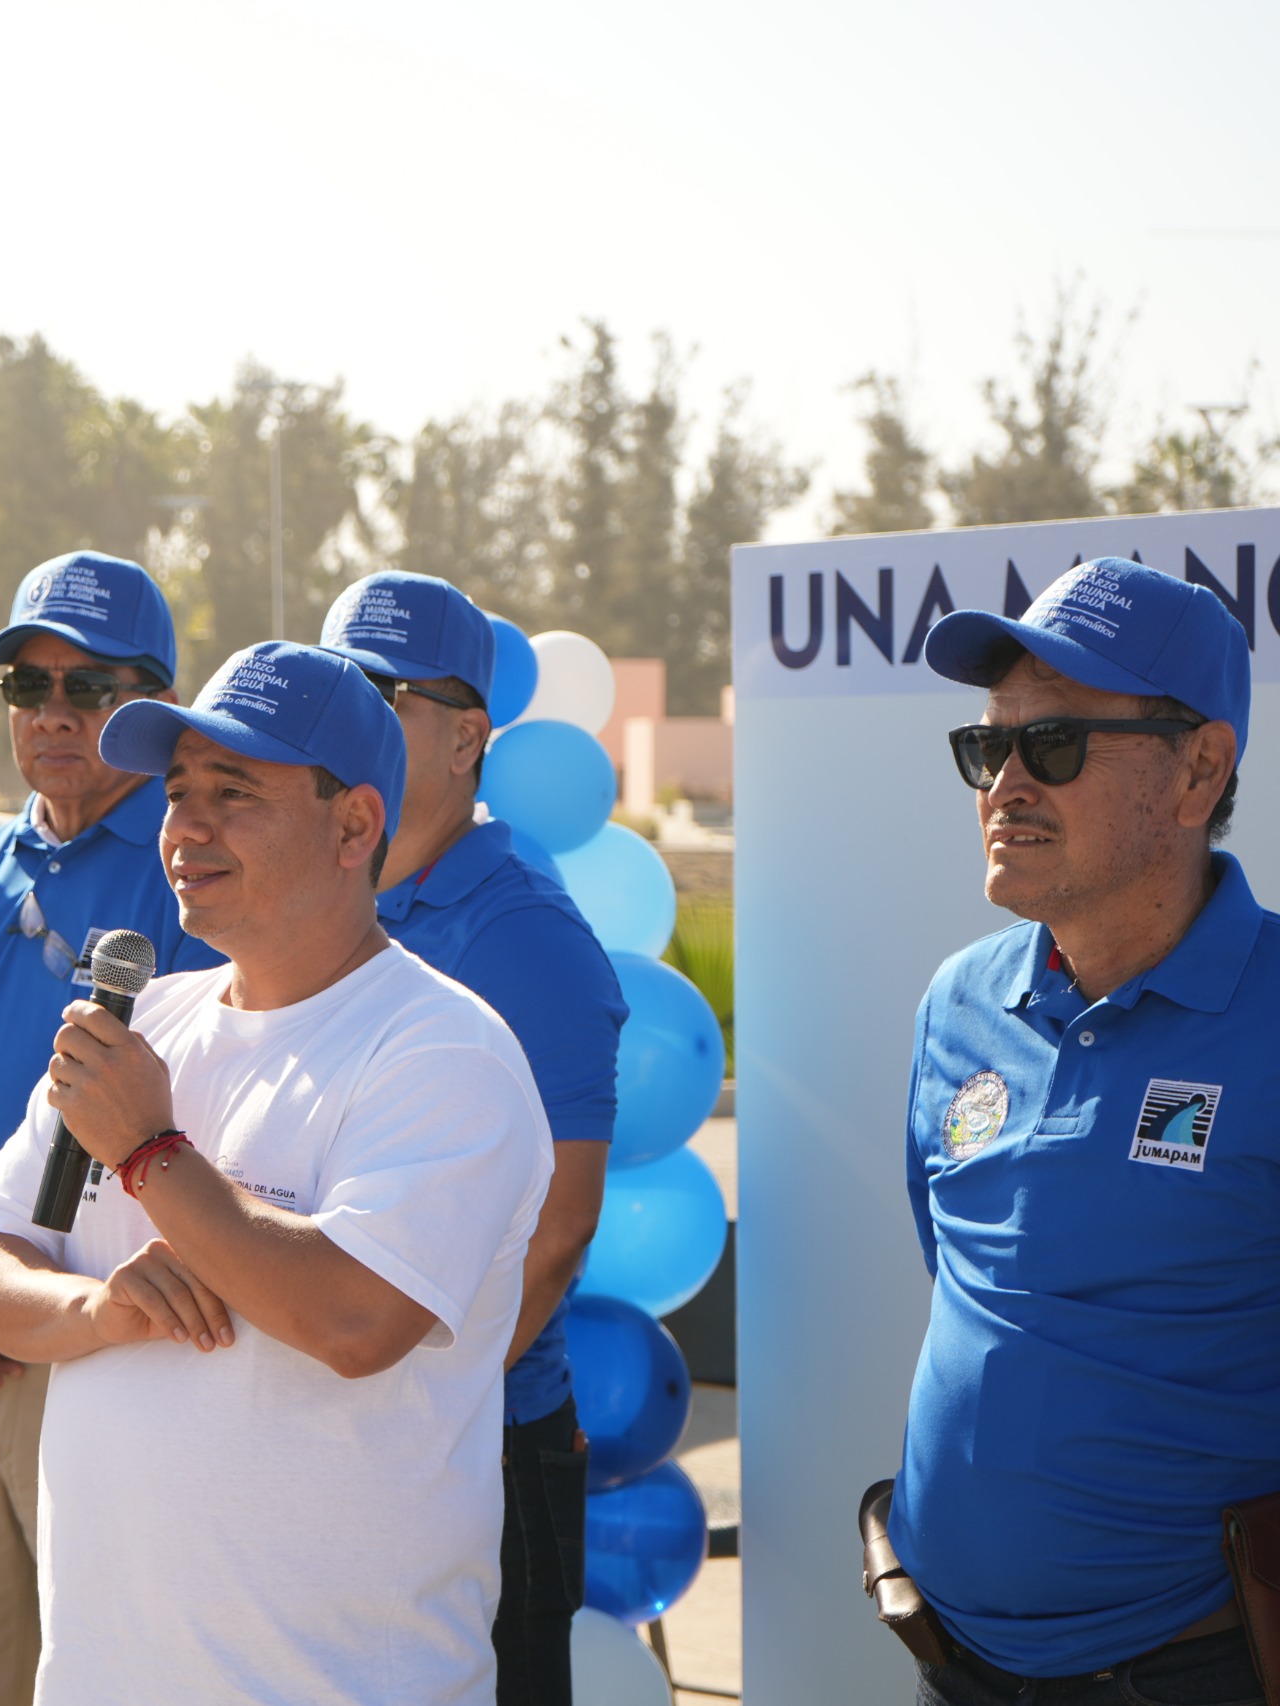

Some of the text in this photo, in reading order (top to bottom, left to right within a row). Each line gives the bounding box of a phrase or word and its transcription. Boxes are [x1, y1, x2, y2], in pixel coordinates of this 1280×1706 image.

[1076, 571, 1120, 592] MARZO
[1066, 591, 1106, 611] AGUA
[1073, 583, 1133, 611] MUNDIAL
[361, 613, 393, 624] AGUA
[364, 605, 411, 620] MUNDIAL
[768, 563, 957, 671] UNA
[1071, 614, 1116, 639] climático
[230, 678, 265, 692] AGUA
[235, 669, 289, 689] MUNDIAL
[234, 697, 276, 715] climático
[254, 1184, 268, 1194] DEL
[269, 1187, 296, 1199] AGUA
